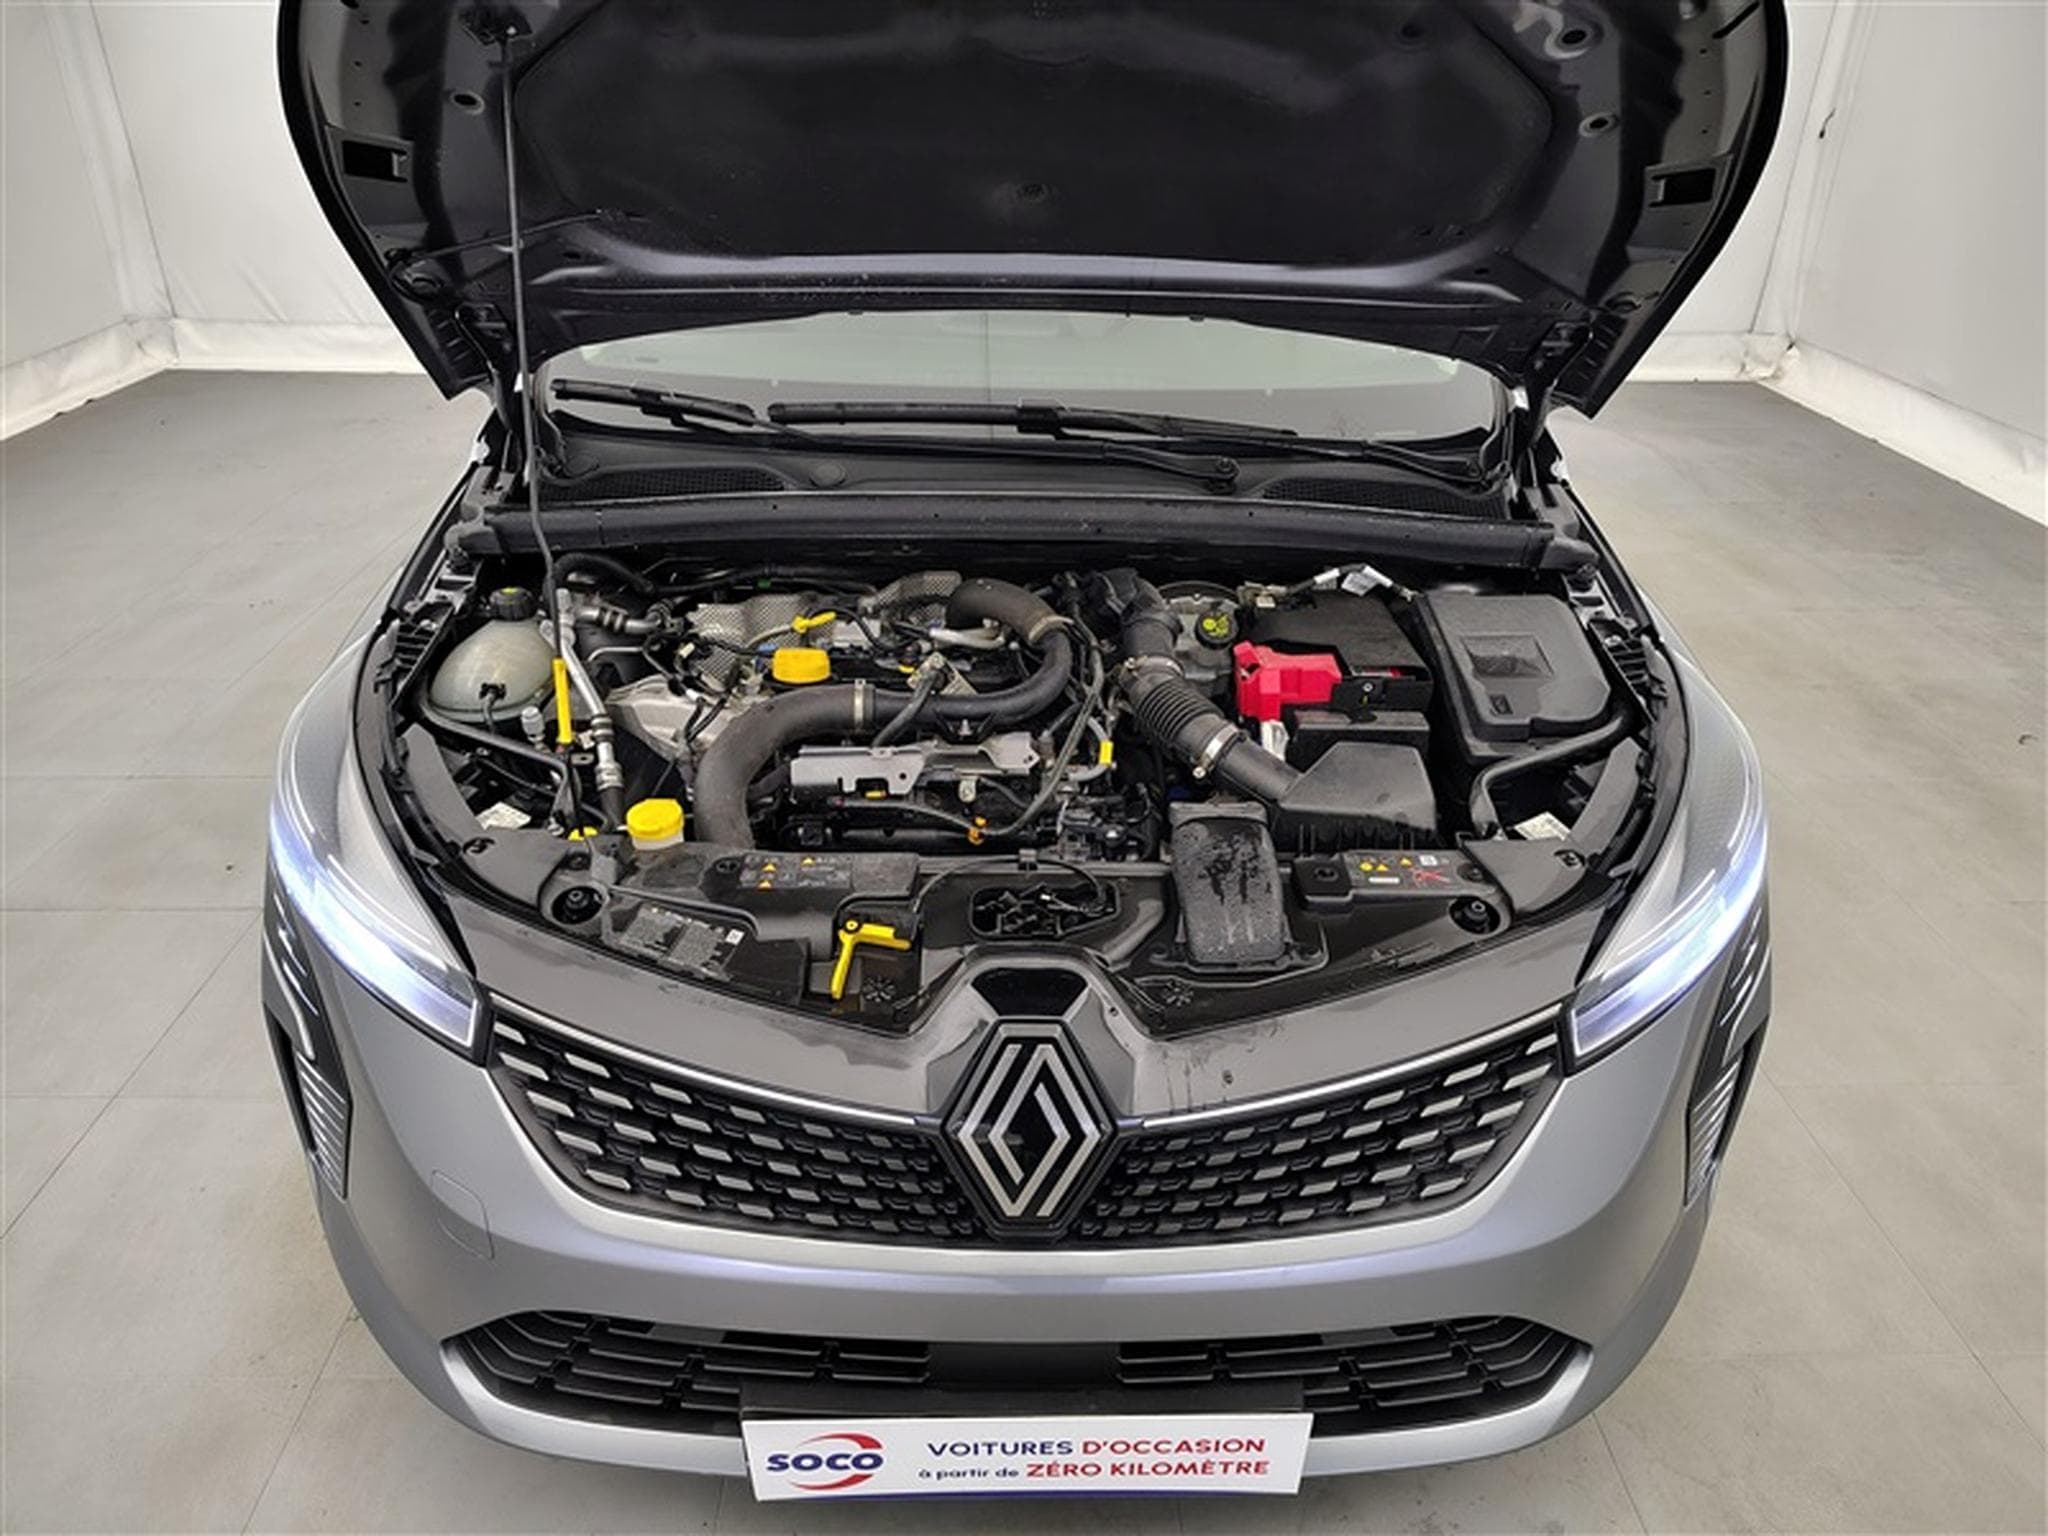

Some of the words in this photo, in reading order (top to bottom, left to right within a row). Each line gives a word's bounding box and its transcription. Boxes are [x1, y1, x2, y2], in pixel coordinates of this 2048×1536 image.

[927, 1440, 1074, 1457] VOITURES
[1082, 1438, 1266, 1455] D'OCCASION
[766, 1452, 884, 1472] SOCO
[918, 1467, 931, 1479] à
[935, 1466, 989, 1481] partir
[994, 1467, 1020, 1478] de
[1026, 1460, 1102, 1478] ZÉRO
[1109, 1458, 1270, 1476] KILOMÈTRE
